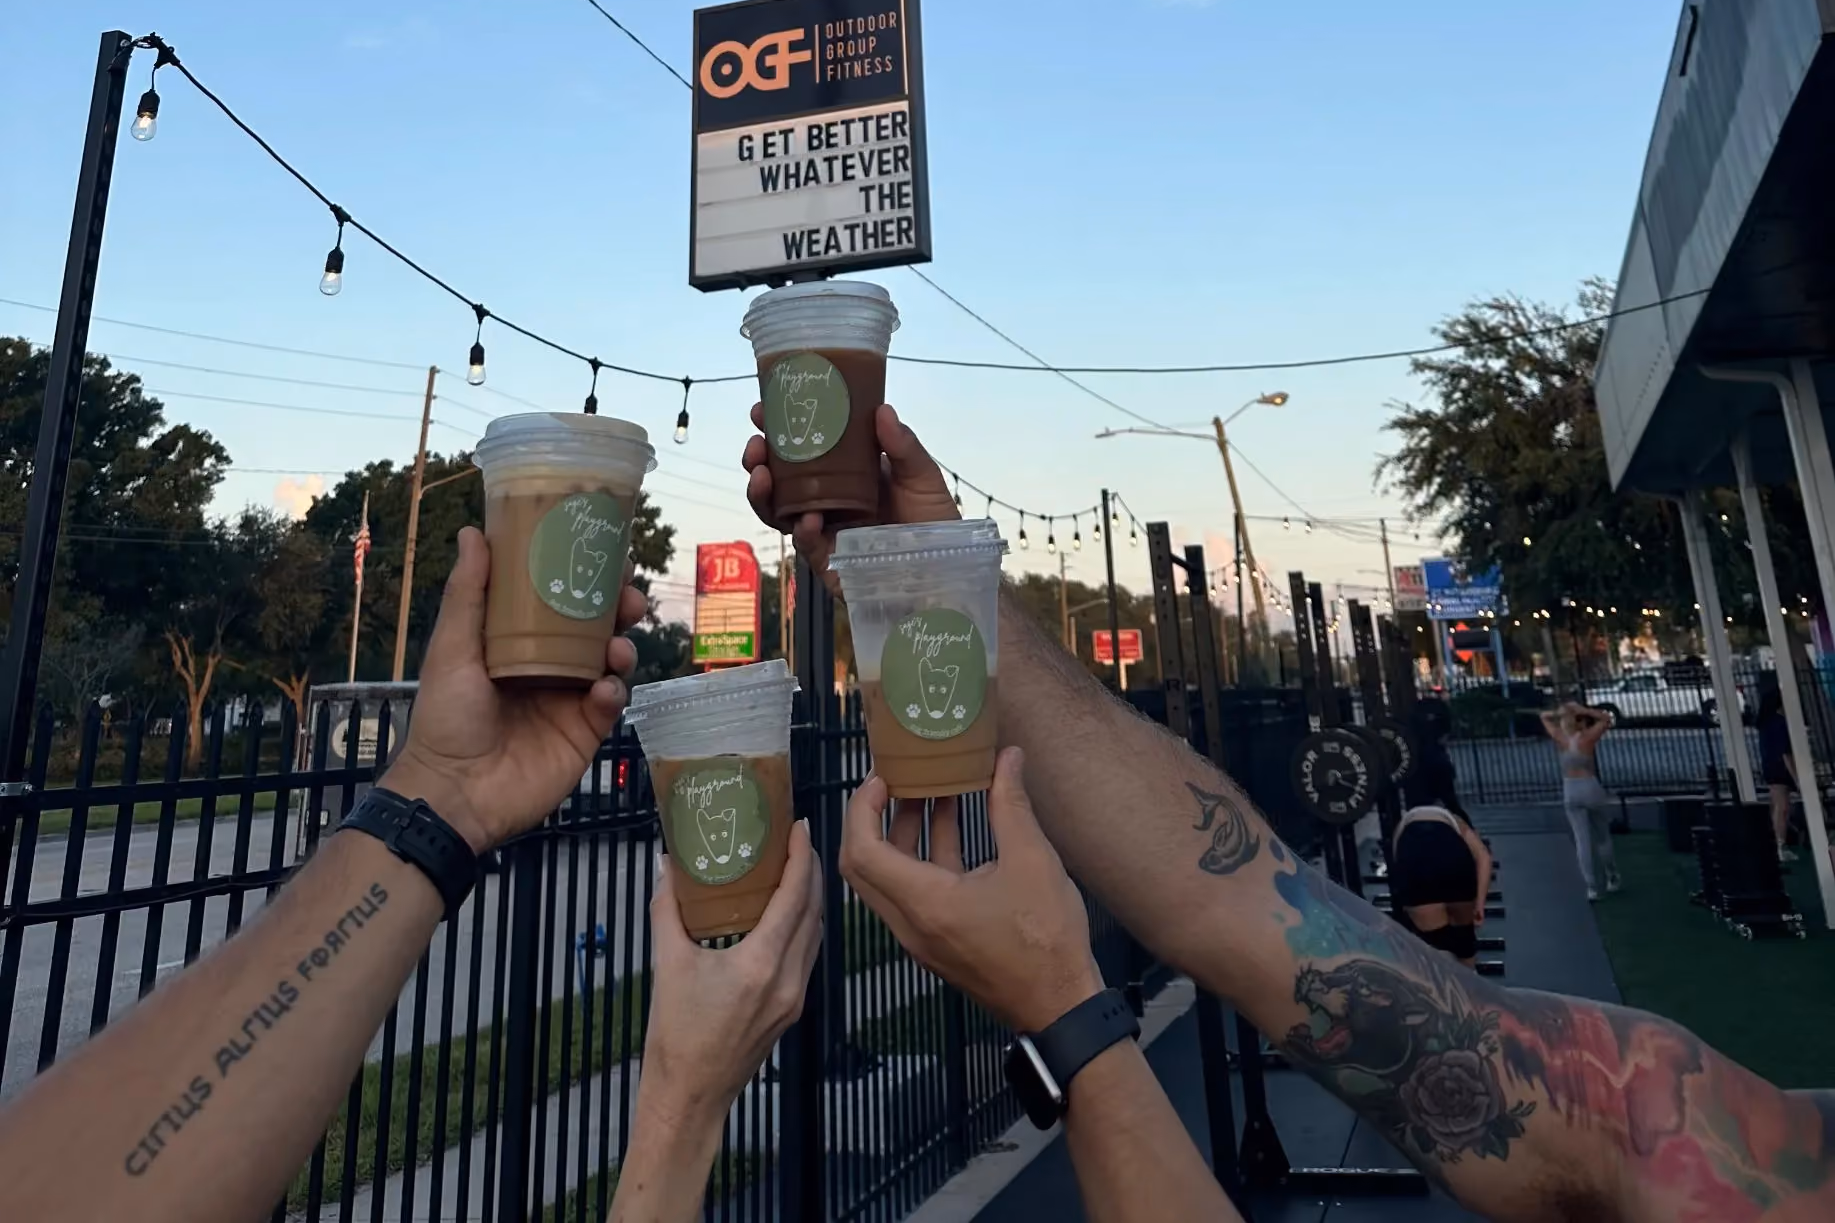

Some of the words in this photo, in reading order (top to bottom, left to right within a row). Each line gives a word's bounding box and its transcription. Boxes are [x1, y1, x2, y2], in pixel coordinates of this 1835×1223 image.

[825, 11, 897, 38] OUTDOOR
[700, 27, 812, 99] OGF
[826, 36, 877, 60] GROUP
[827, 55, 893, 82] FITNESS
[807, 110, 908, 152] BETTER
[760, 144, 910, 193] WHATEVER
[859, 180, 912, 213] THE
[783, 215, 914, 262] WEATHER
[1302, 749, 1319, 803] VALOR
